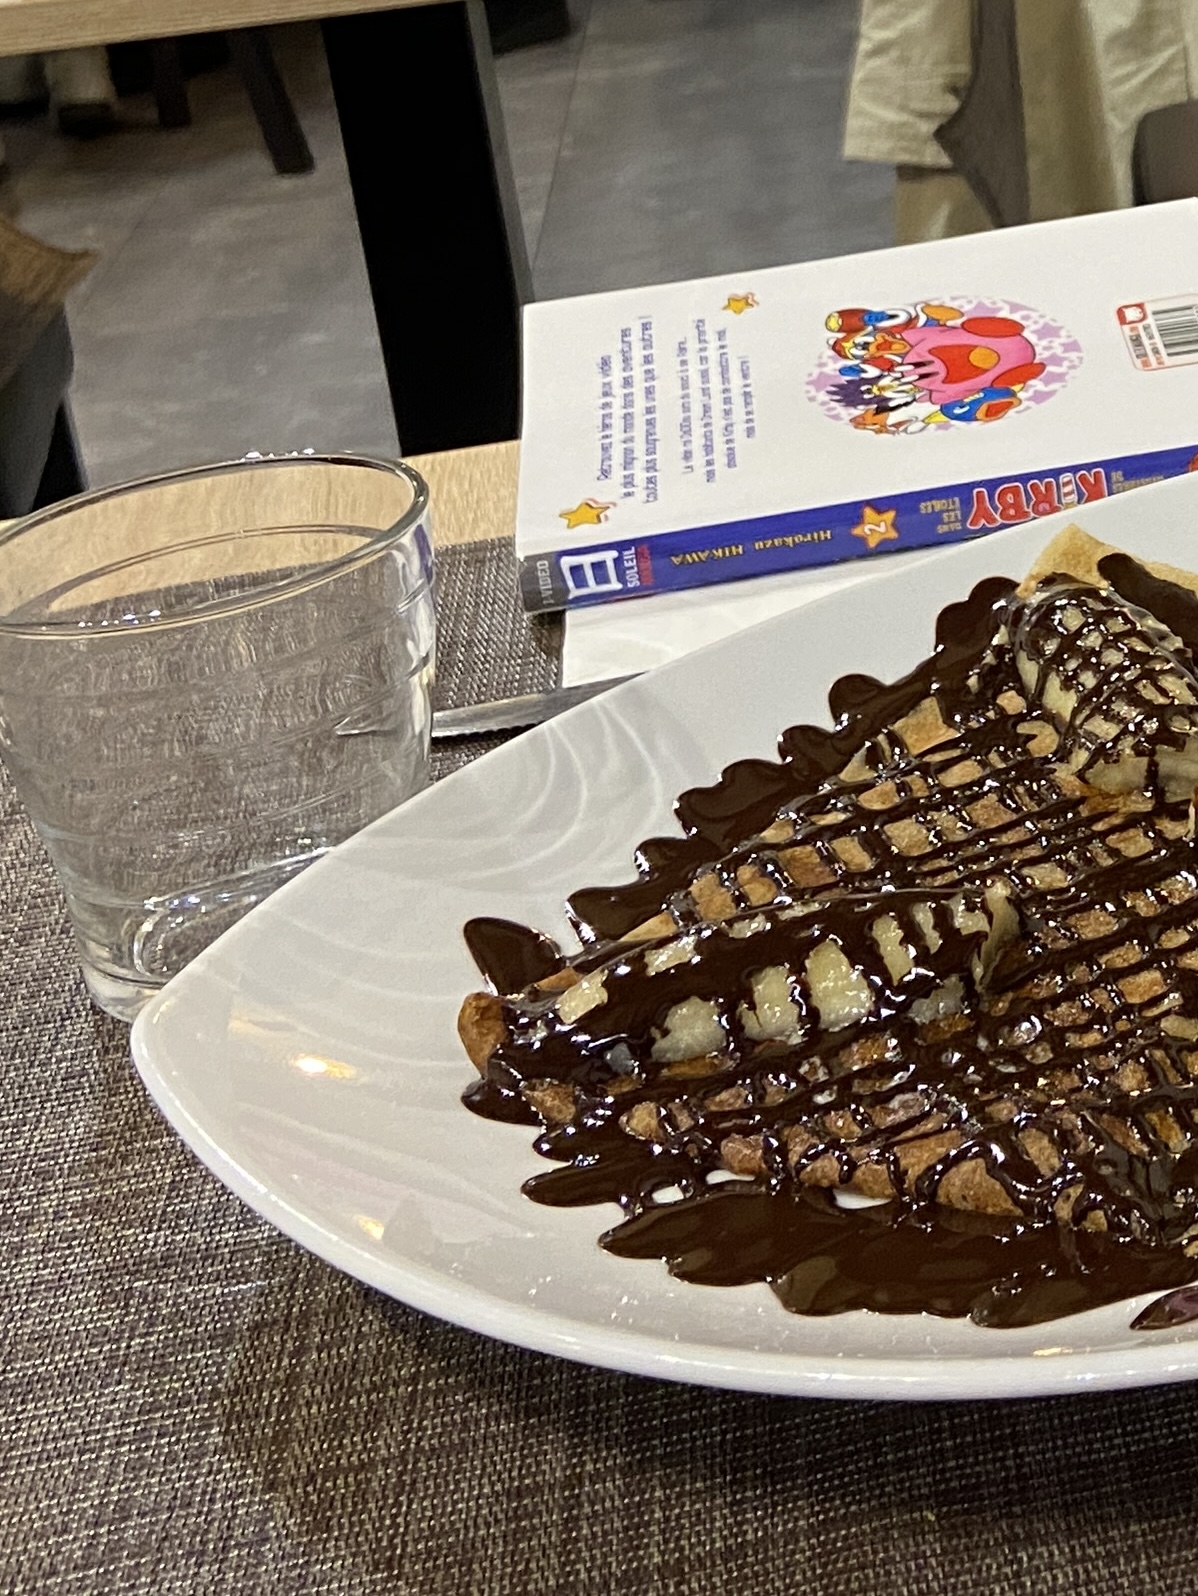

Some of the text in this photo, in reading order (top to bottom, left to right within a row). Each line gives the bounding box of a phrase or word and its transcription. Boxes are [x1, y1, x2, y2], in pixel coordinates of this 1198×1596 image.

[966, 468, 1108, 528] KIRBY
[670, 529, 832, 566] Hirokazu HIKAWA
[864, 521, 886, 535] 2
[624, 546, 640, 587] SOLEIL
